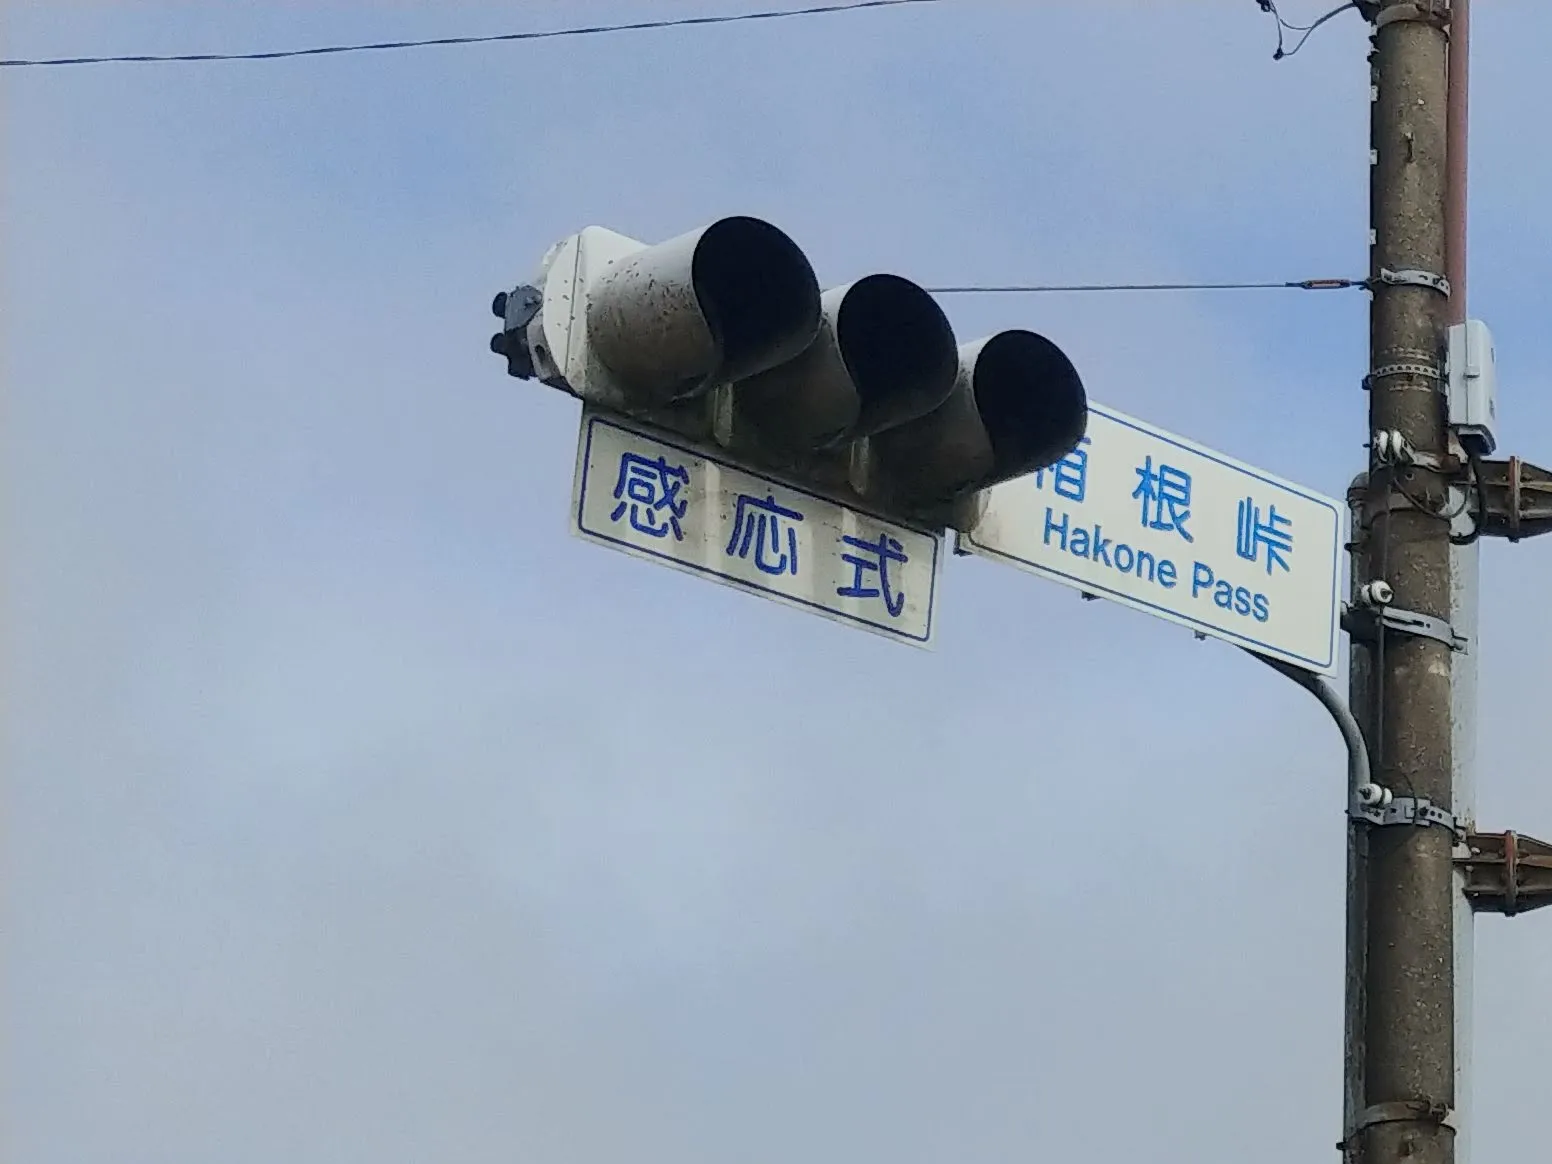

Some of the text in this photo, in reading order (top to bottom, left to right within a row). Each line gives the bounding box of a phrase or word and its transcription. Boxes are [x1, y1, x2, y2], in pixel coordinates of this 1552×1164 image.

[611, 452, 907, 617] 感応式
[1043, 508, 1270, 623] Hakone Pass
